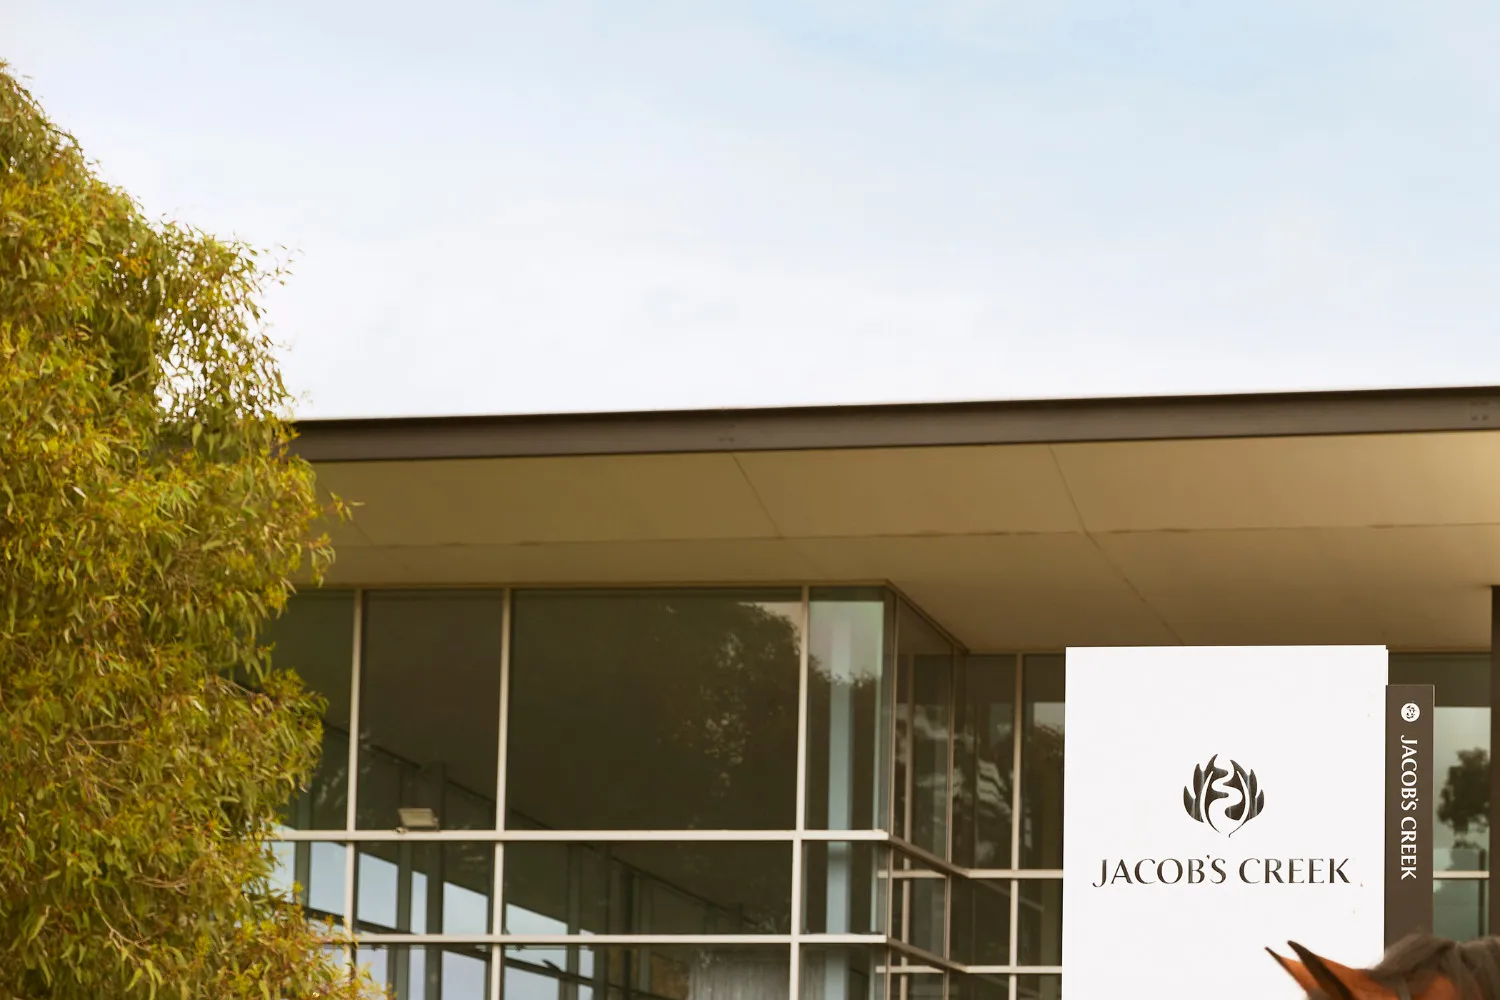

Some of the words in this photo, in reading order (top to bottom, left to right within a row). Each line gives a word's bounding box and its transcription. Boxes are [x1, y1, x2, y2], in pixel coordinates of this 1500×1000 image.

[1401, 735, 1419, 811] JACOB'S
[1092, 855, 1227, 888] JACOB'S
[1238, 857, 1351, 884] CREEK
[1401, 817, 1417, 880] CREEK
